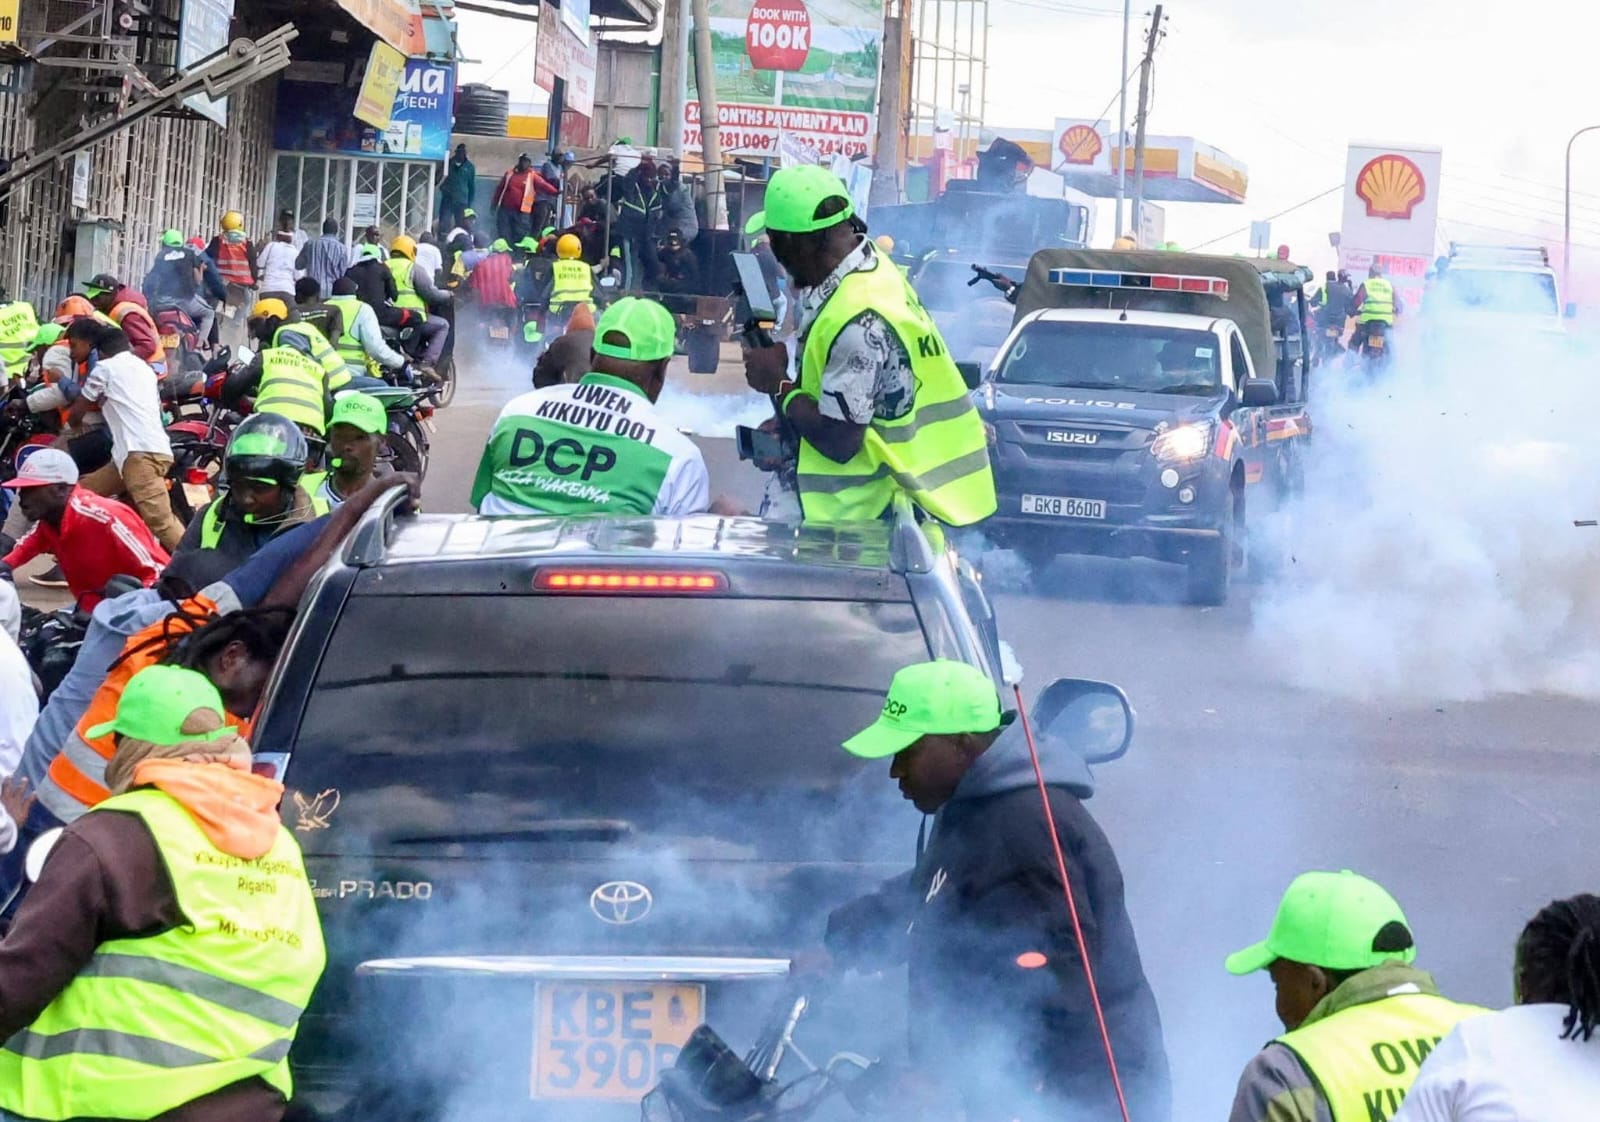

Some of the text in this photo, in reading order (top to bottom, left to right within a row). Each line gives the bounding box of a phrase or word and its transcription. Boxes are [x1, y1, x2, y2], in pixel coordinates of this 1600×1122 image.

[752, 7, 807, 22] BOOK WITH
[749, 22, 809, 50] 100K
[718, 106, 764, 126] ONTHS
[765, 110, 829, 132] PAYMENT
[830, 115, 865, 134] PLAN
[917, 333, 945, 357] KI
[572, 384, 633, 415] OWEN
[1024, 397, 1137, 410] POLICE
[535, 400, 656, 445] KIKUYU 001
[1047, 431, 1097, 444] ISUZU
[509, 428, 617, 481] DCP
[340, 880, 433, 900] PRADO
[552, 990, 654, 1039] KBE
